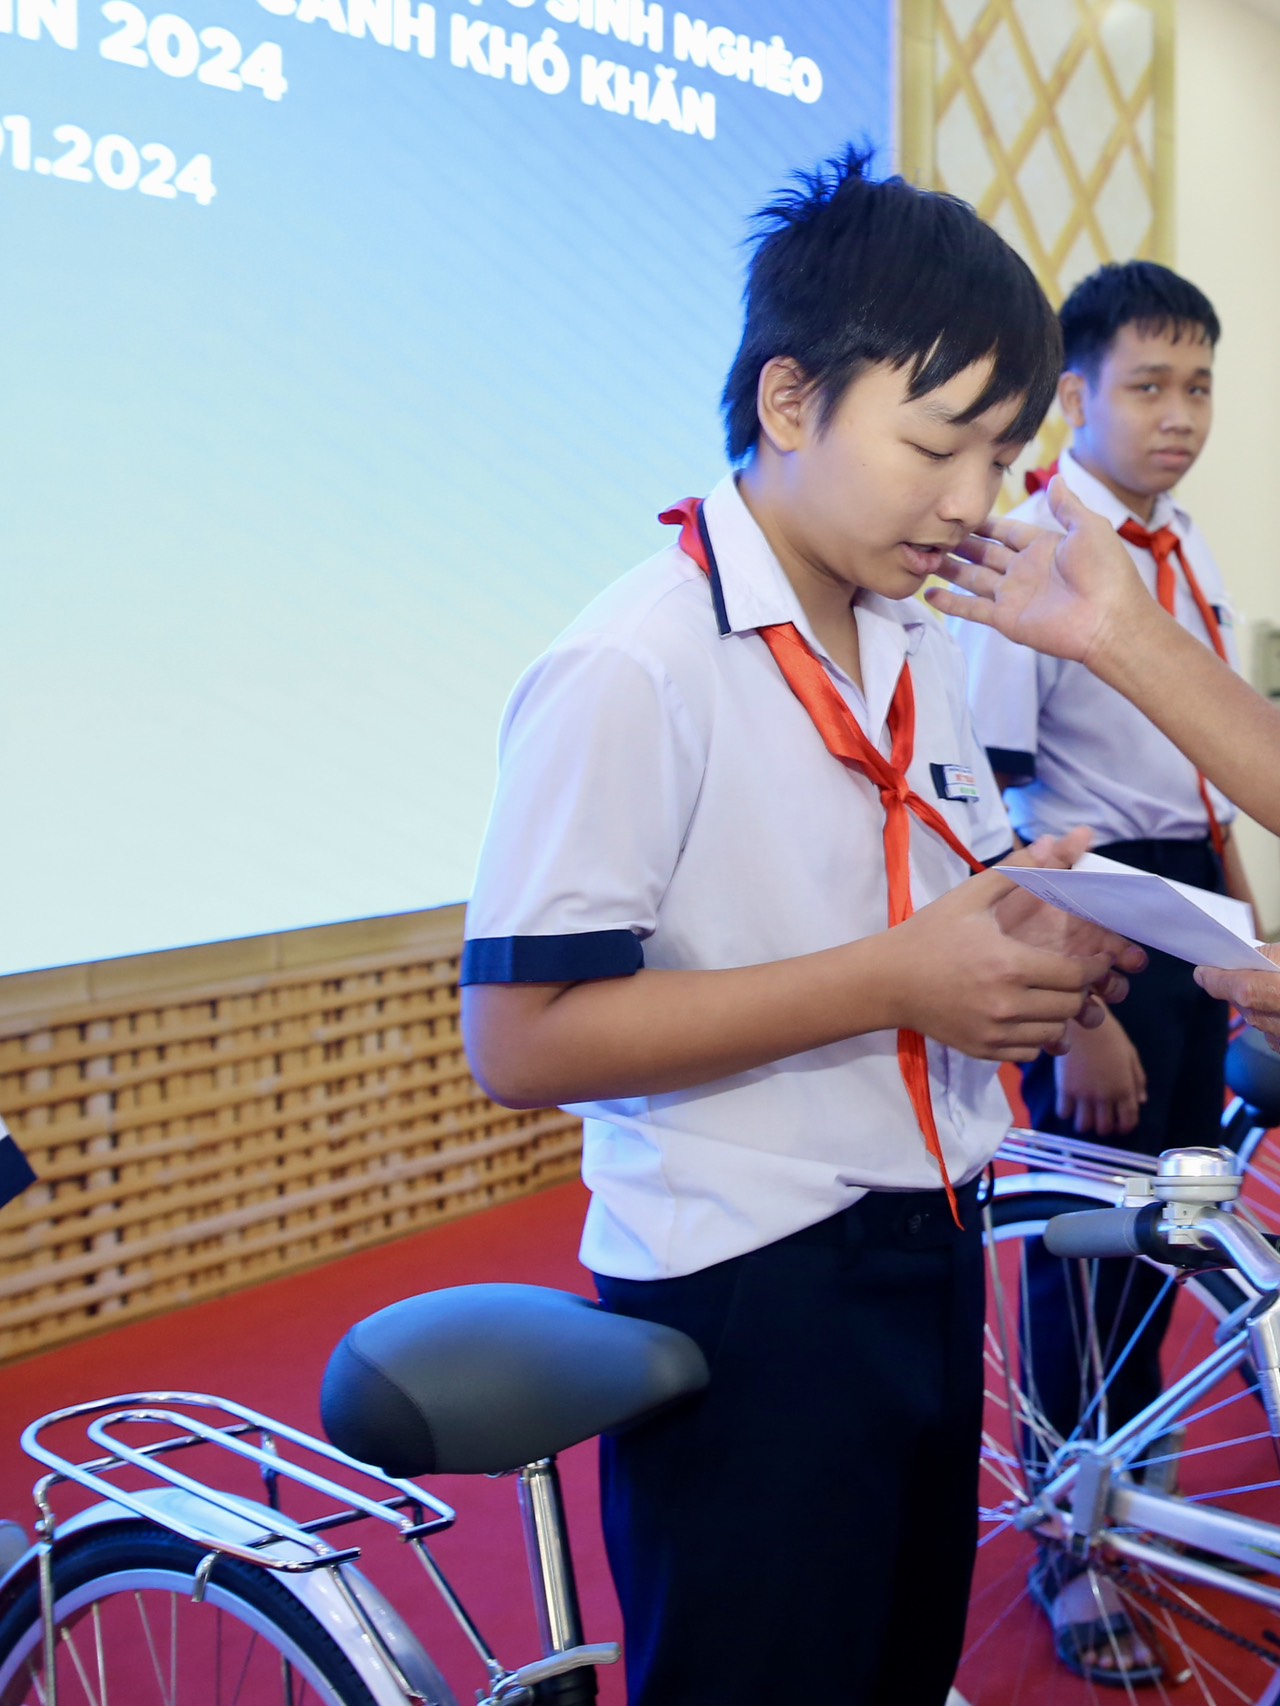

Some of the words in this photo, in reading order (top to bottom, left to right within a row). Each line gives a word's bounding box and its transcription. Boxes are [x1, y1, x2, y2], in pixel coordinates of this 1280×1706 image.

[99, 0, 288, 102] 2024
[450, 13, 571, 95] KHÓ
[581, 55, 716, 140] KHĂN
[673, 12, 823, 103] NGHÈO
[0, 114, 217, 206] 1.2024
